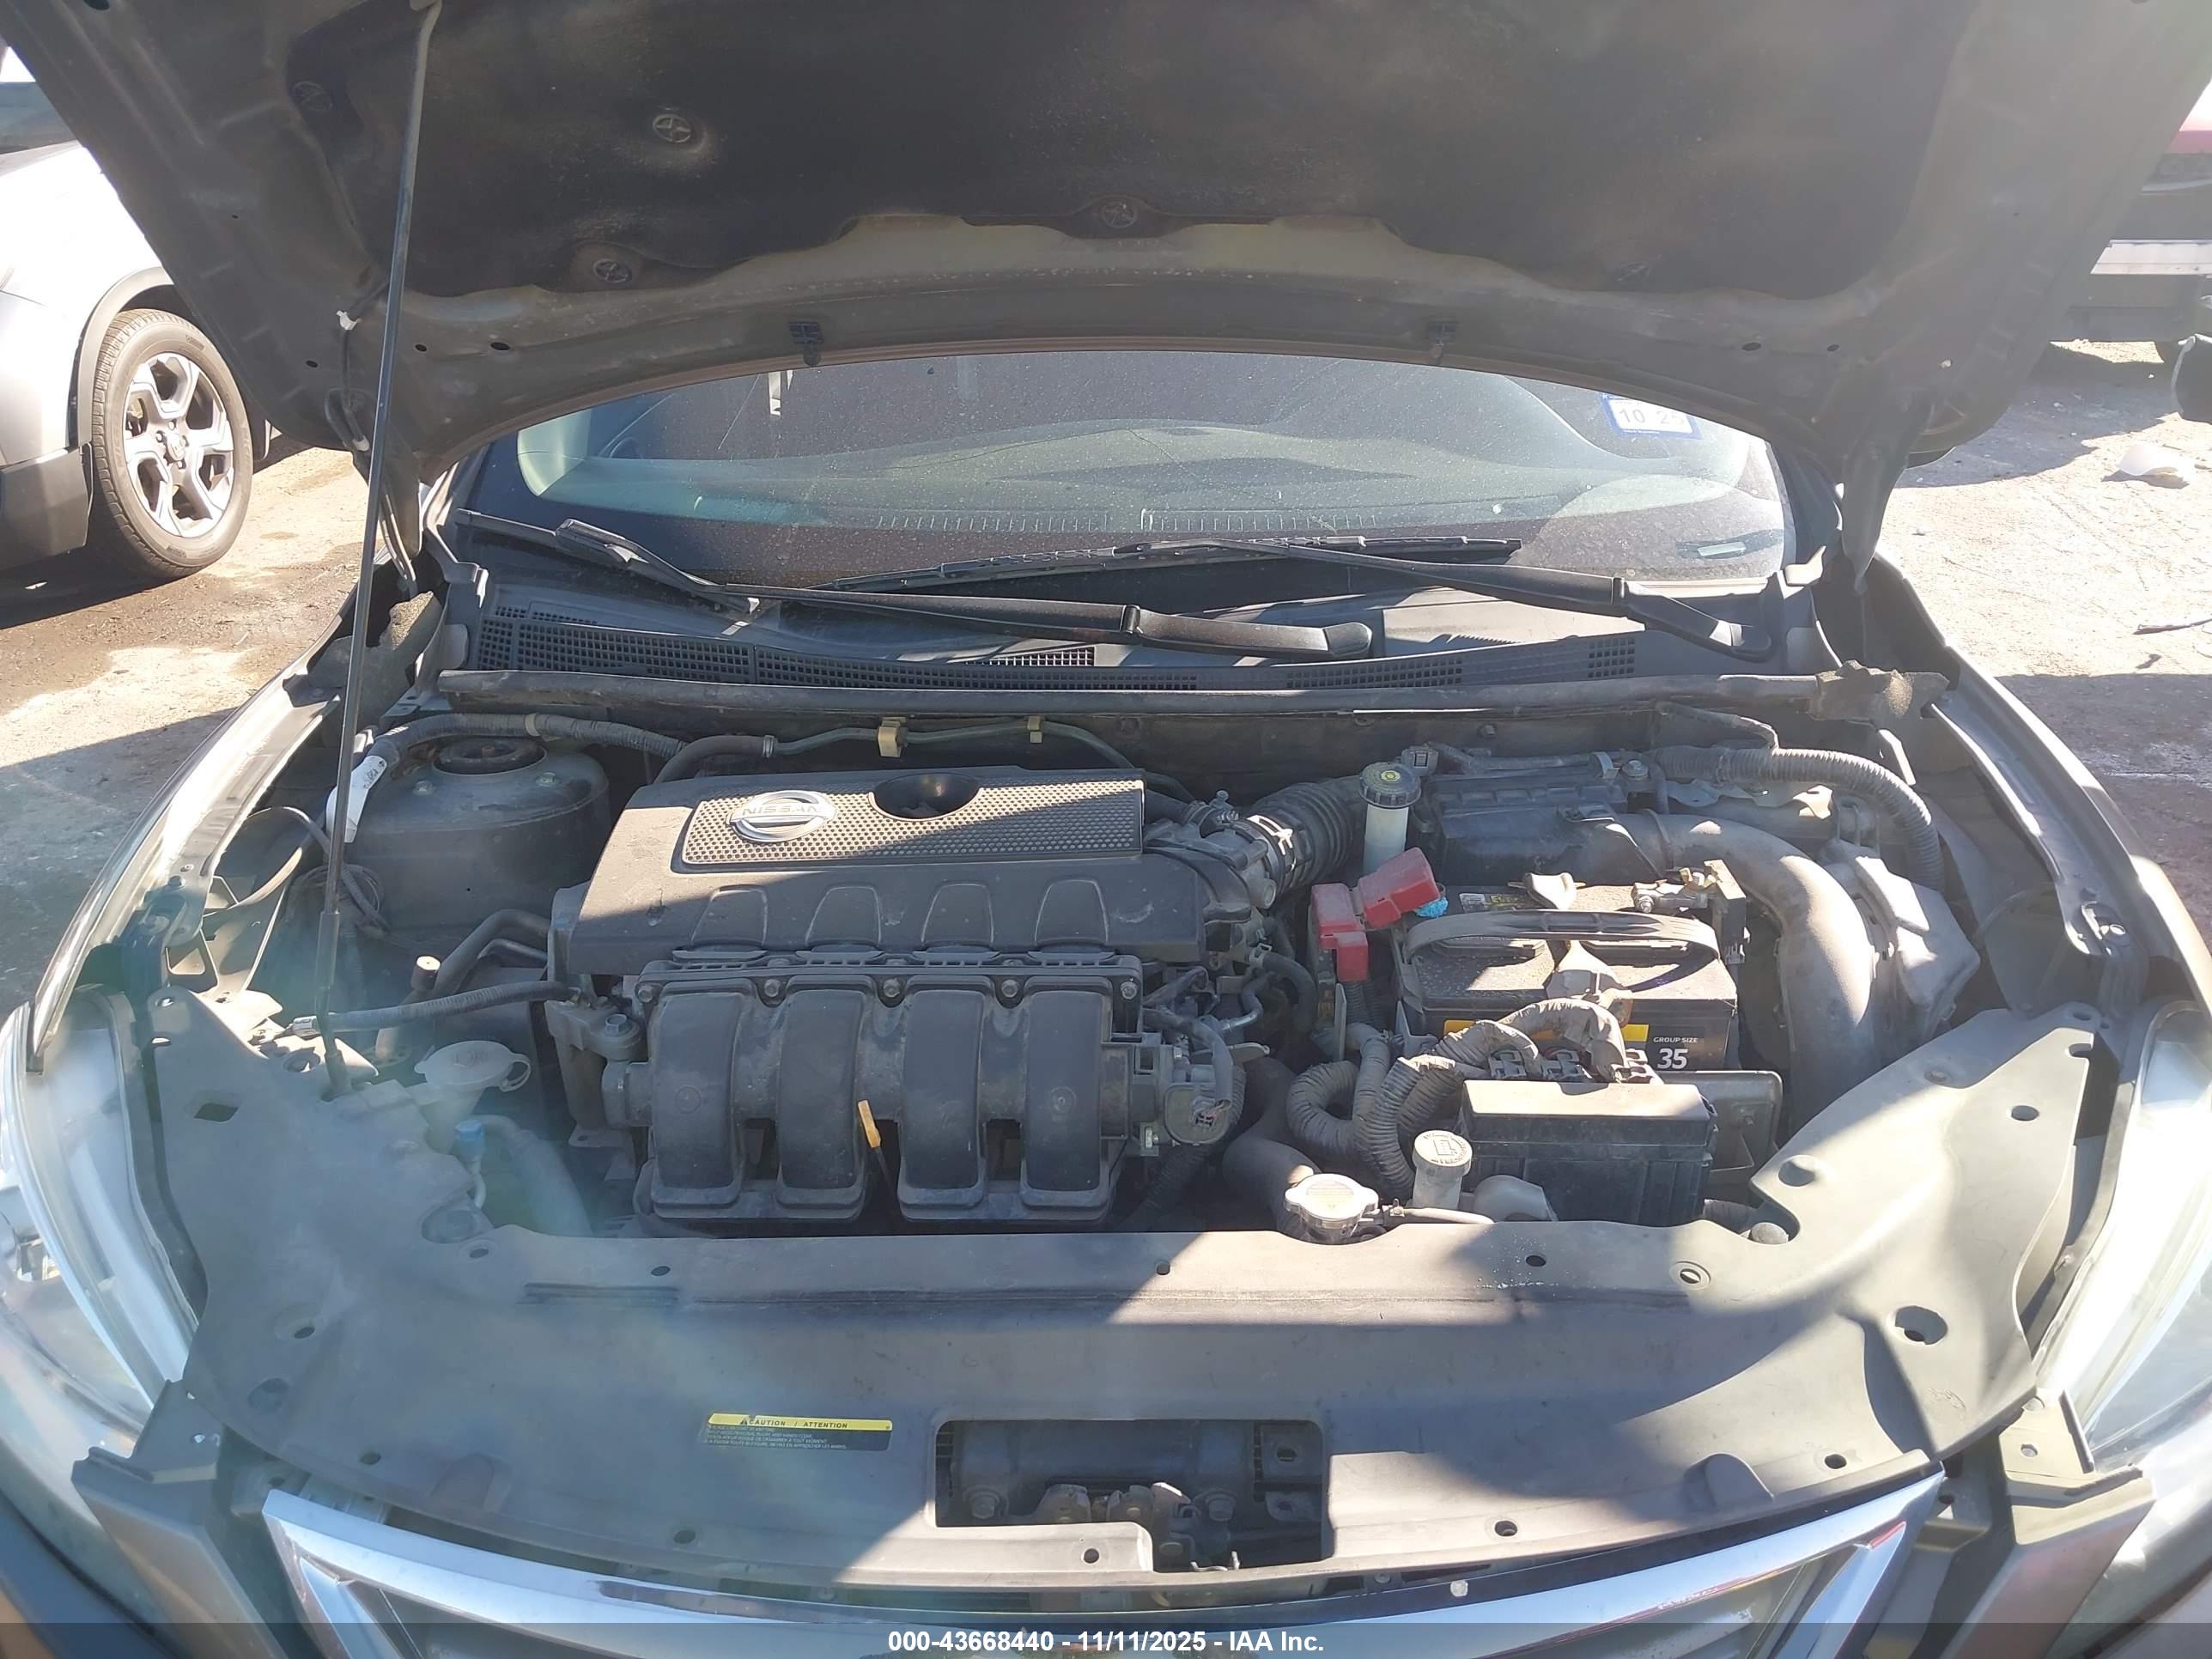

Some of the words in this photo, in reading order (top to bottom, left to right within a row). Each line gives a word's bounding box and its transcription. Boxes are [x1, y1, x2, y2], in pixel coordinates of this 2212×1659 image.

[1620, 408, 1646, 423] 10
[743, 804, 821, 815] NISSAN
[1656, 1048, 1689, 1069] 35
